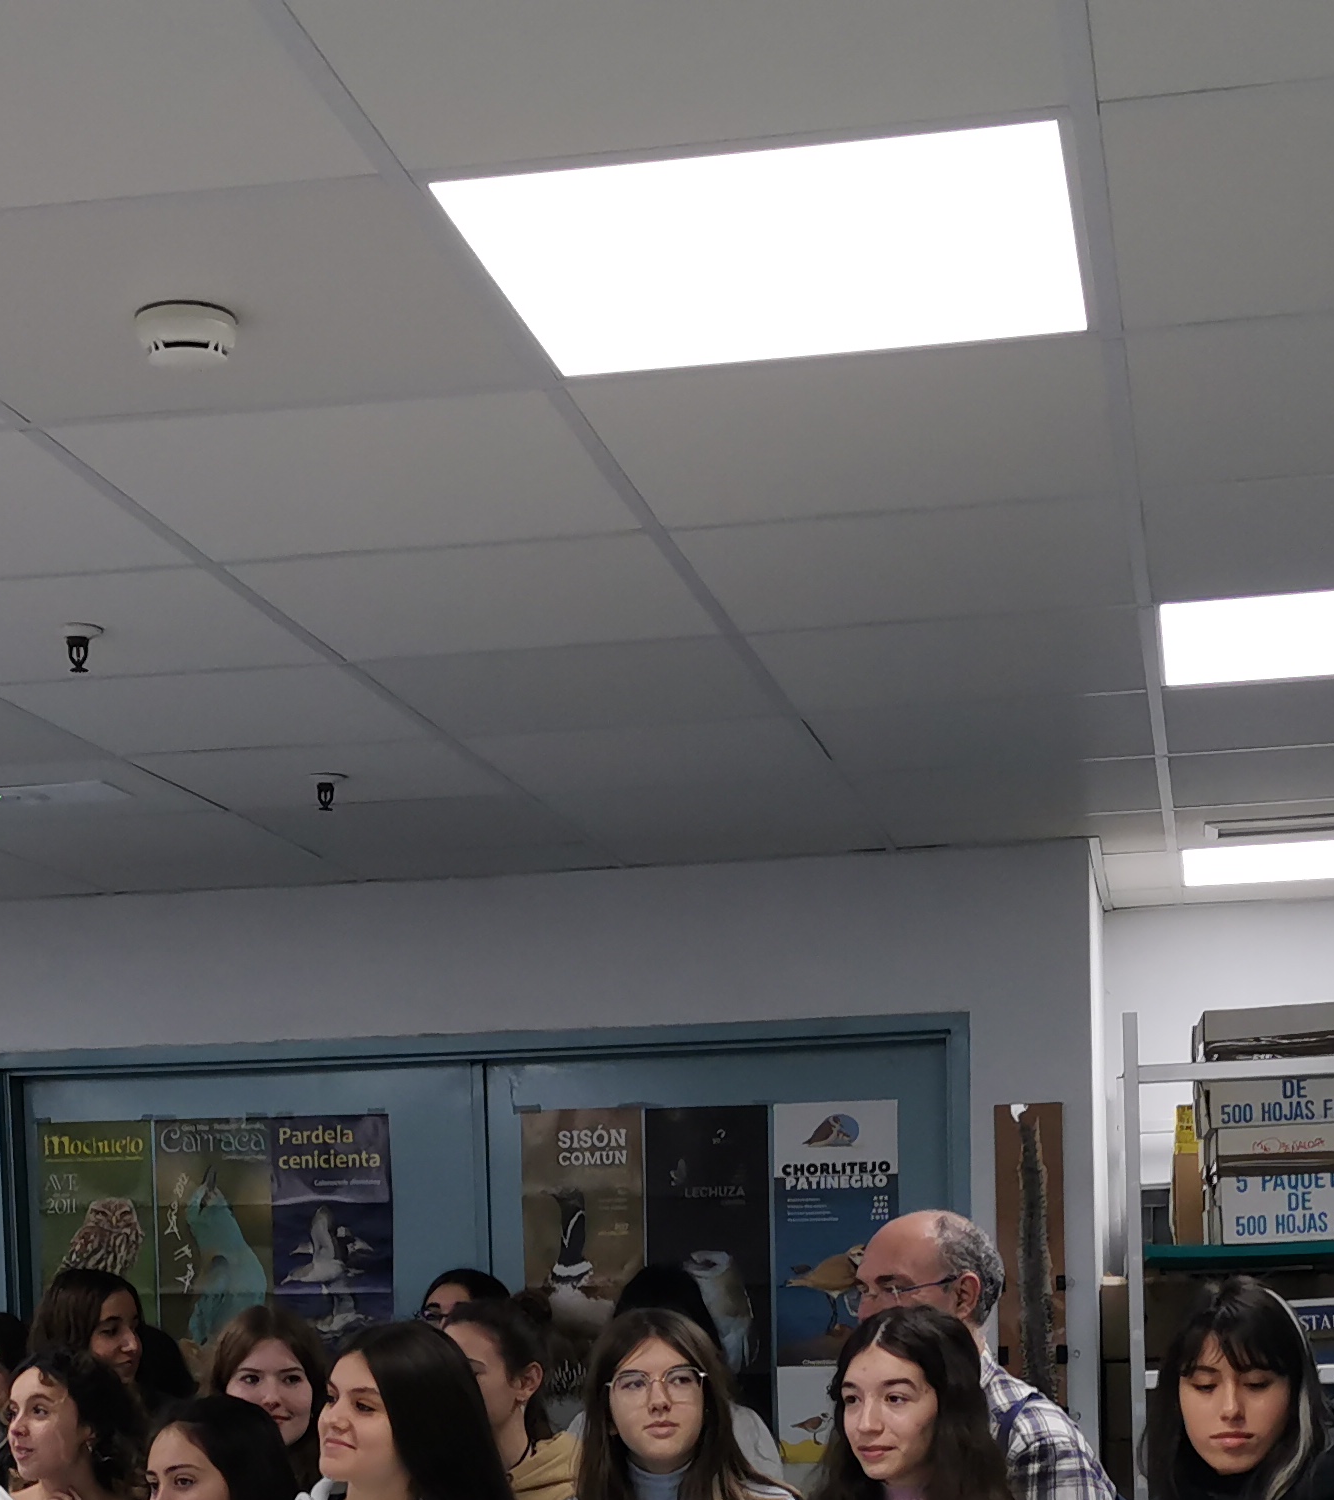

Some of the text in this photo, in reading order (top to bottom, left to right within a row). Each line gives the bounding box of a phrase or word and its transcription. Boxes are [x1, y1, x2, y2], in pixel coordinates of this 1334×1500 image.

[1282, 1079, 1308, 1099] DE
[1220, 1104, 1253, 1124] 500
[1261, 1100, 1315, 1122] HOJAS
[160, 1126, 266, 1153] Carraca
[278, 1124, 354, 1145] Pardela
[557, 1124, 627, 1149] SISÓN
[44, 1134, 144, 1156] Mochuelo
[278, 1149, 381, 1169] cenicienta
[558, 1147, 627, 1166] COMÚN
[781, 1160, 891, 1177] CHORLITEJO
[683, 1185, 746, 1199] LECHUZA
[785, 1174, 888, 1190] PATINEGRO
[1236, 1176, 1248, 1193] 5
[46, 1198, 77, 1214] 2011
[1287, 1191, 1313, 1212] DE
[1235, 1214, 1267, 1237] 500
[1275, 1211, 1328, 1235] HOJAS
